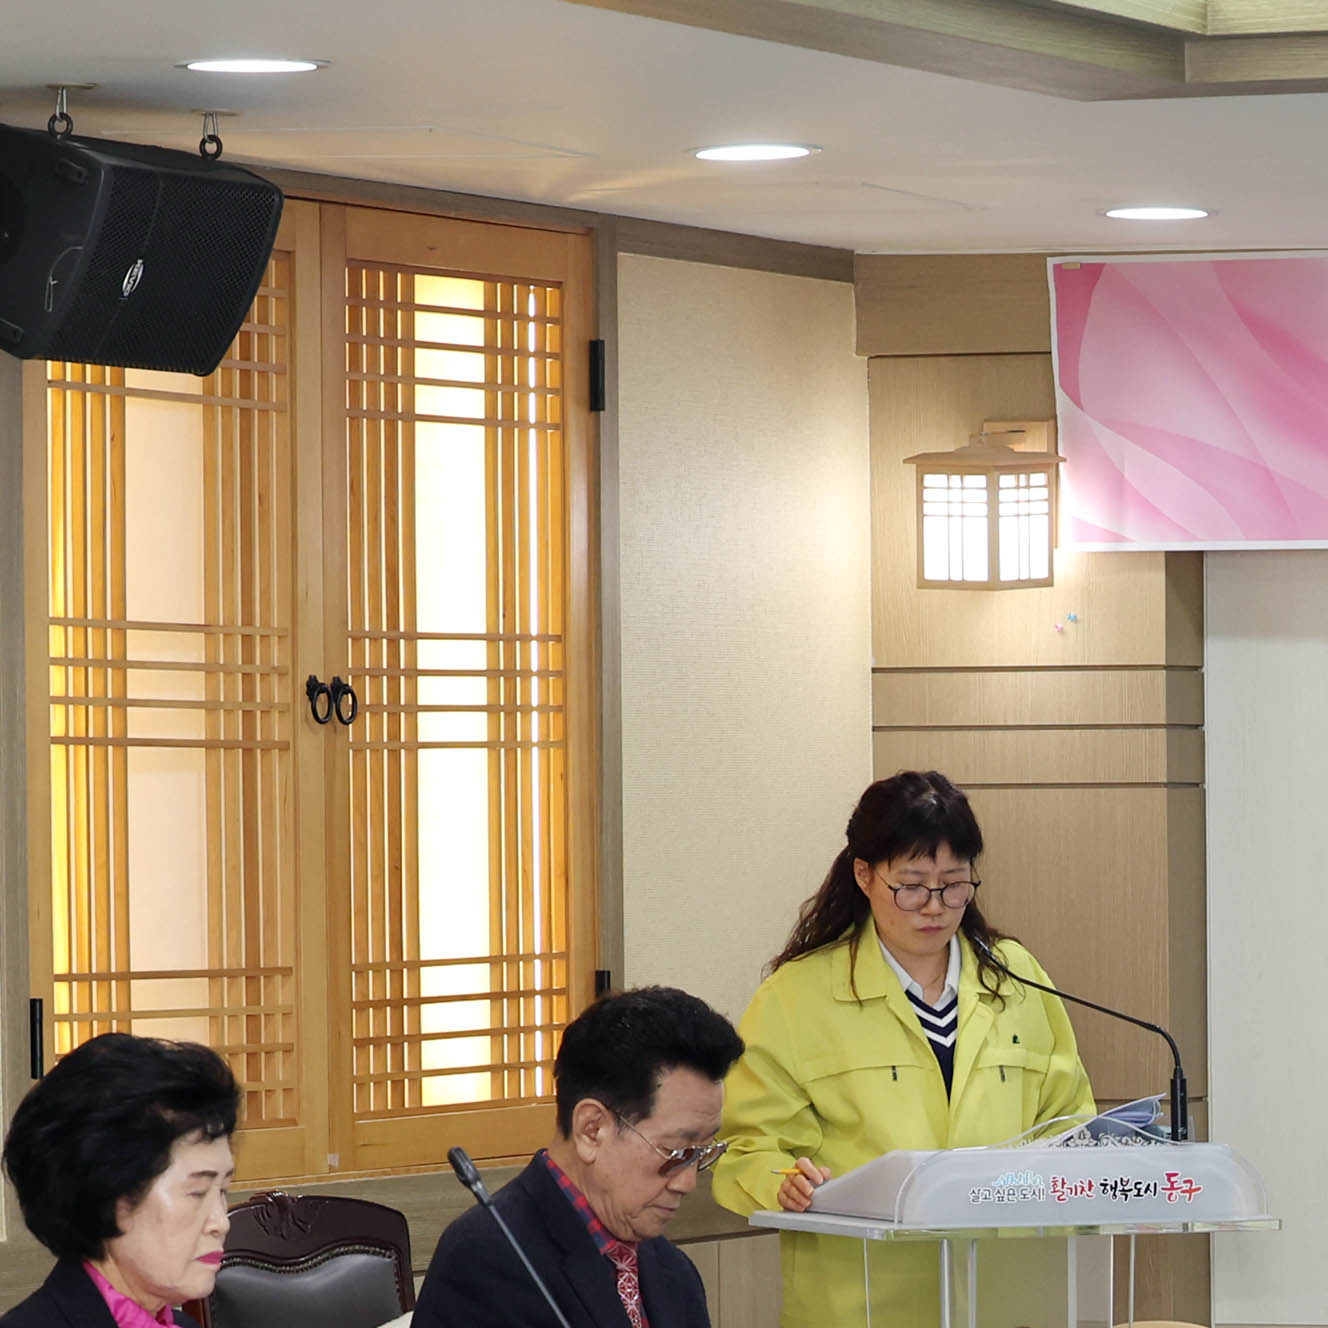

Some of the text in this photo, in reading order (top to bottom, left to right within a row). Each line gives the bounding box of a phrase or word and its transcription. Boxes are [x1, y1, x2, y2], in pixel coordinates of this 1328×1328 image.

[970, 1187, 992, 1203] 살고
[994, 1187, 1017, 1203] 싶은
[1049, 1176, 1095, 1202] 활기찬
[1099, 1176, 1158, 1202] 행복도시
[1160, 1172, 1202, 1203] 동구
